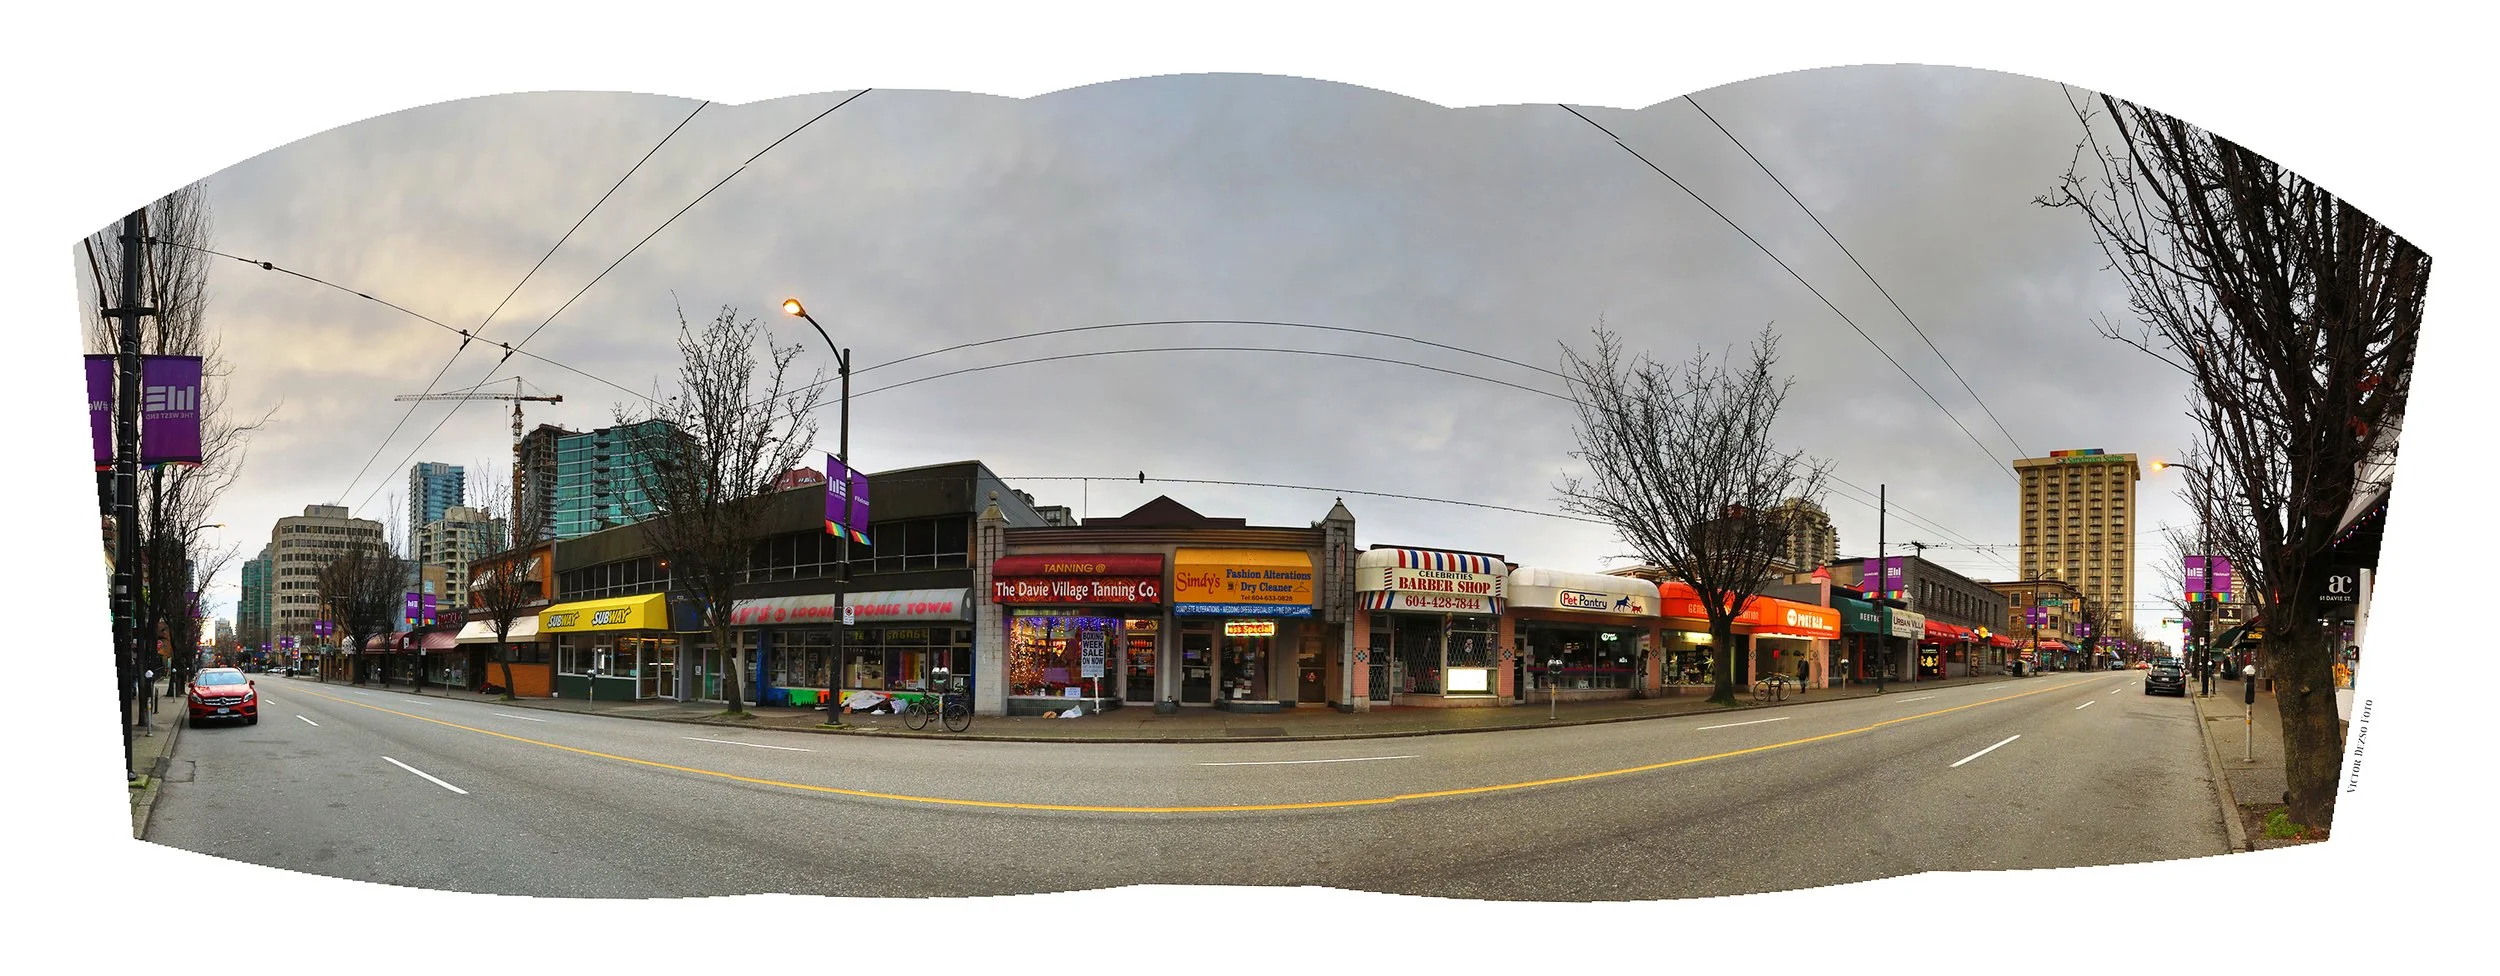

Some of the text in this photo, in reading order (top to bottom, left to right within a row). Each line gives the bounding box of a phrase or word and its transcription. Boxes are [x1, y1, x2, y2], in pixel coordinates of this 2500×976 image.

[1044, 563, 1106, 573] TANNING @
[1226, 569, 1312, 580] Fashion Alterations
[1419, 570, 1473, 580] CELEBRITIES
[1175, 572, 1220, 594] Simdy's
[1241, 582, 1257, 593] Dry
[1259, 582, 1293, 593] Cleaner
[1399, 577, 1491, 594] BARBER SHOP
[996, 582, 1157, 600] The Davie Village Tanning Co.
[1405, 595, 1481, 609] 604-428-7844
[1563, 593, 1607, 609] Pet Pantry
[791, 605, 834, 619] LOONI
[854, 604, 902, 617] OONIE
[907, 601, 953, 616] TOWN
[1175, 605, 1195, 613] COMPLETE
[1195, 605, 1220, 613] ALTERATIONS
[1252, 605, 1274, 614] SPECIALIST
[547, 611, 580, 628] SUBWAY
[592, 607, 632, 626] SUBWAY
[1893, 616, 1911, 627] URBAN
[1911, 619, 1924, 629] VILLA
[1082, 632, 1103, 640] BOXING
[1083, 657, 1103, 665] ON NOW
